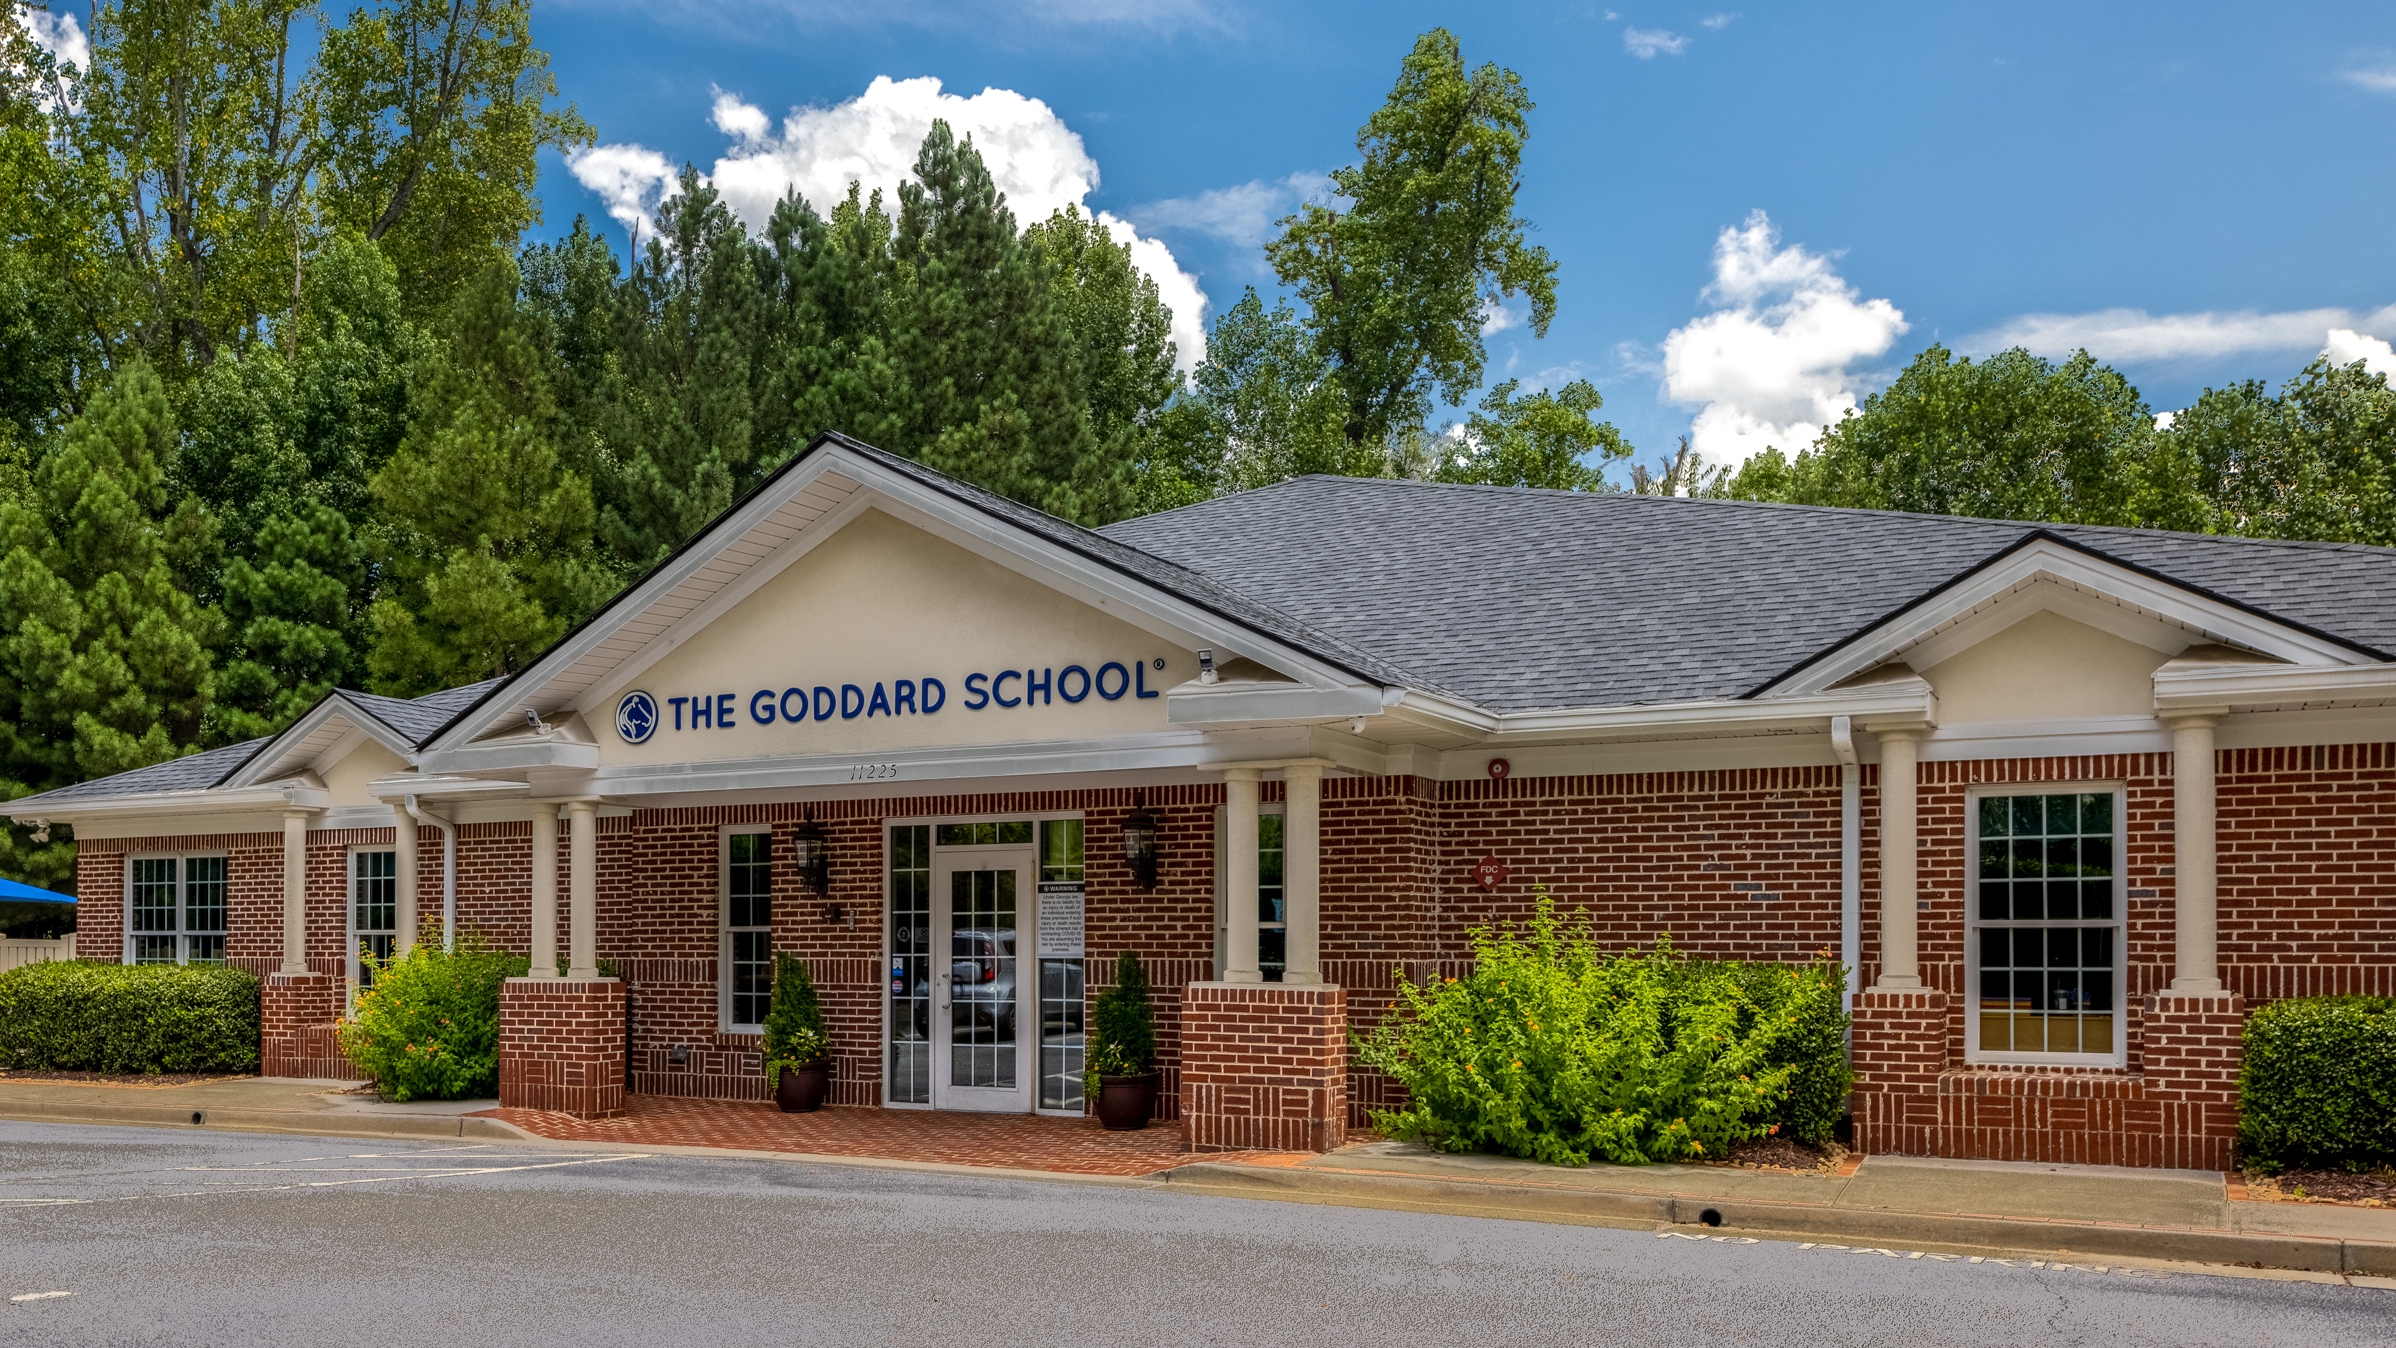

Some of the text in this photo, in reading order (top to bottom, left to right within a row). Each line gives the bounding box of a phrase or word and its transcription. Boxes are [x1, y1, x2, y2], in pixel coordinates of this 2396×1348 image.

[667, 693, 736, 731] THE
[749, 677, 947, 725] GODDARD
[850, 764, 897, 781] 11225
[1480, 865, 1498, 874] FDC
[1655, 1232, 1761, 1245] NO
